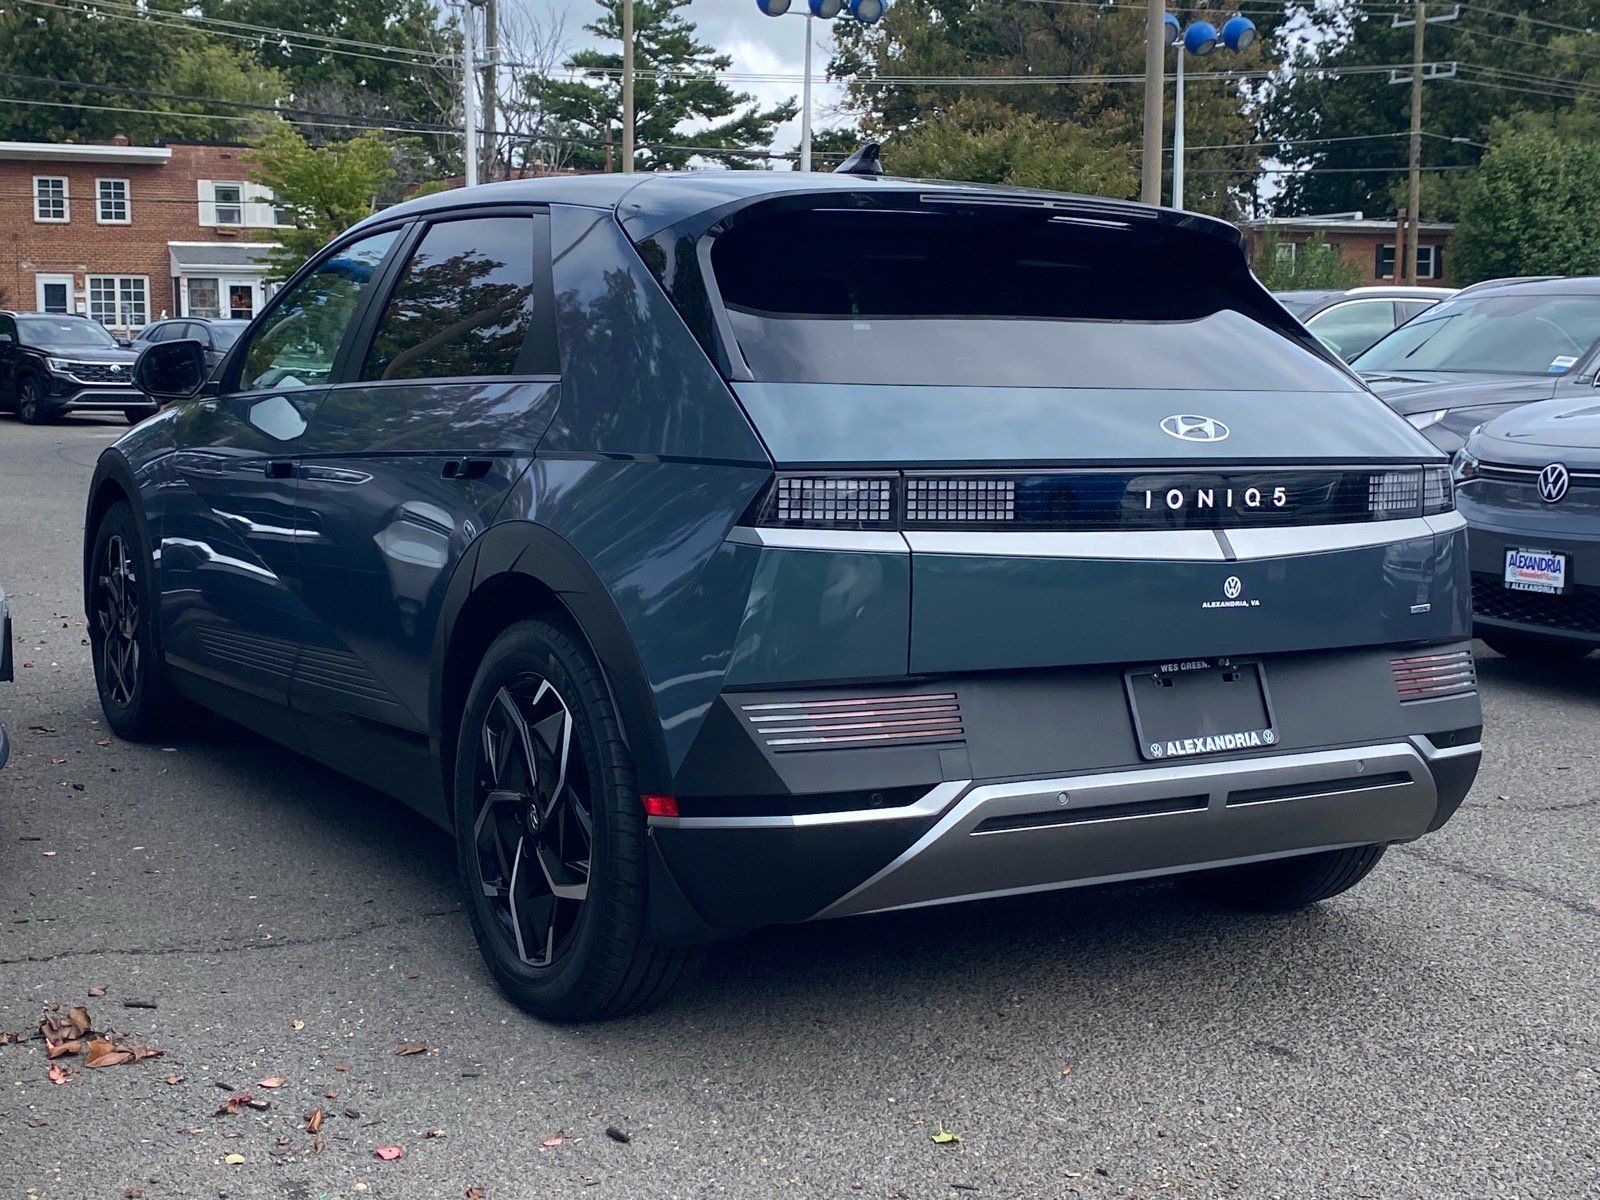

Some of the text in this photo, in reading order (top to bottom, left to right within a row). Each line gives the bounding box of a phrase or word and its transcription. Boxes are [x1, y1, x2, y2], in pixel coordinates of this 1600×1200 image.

[1509, 553, 1562, 574] ALEXANDRIA
[1510, 582, 1555, 594] ALEXANDRIA
[1202, 600, 1249, 608] ALEXANDRIA,
[1160, 663, 1179, 673] WES
[1166, 731, 1261, 756] ALEXANDRIA
